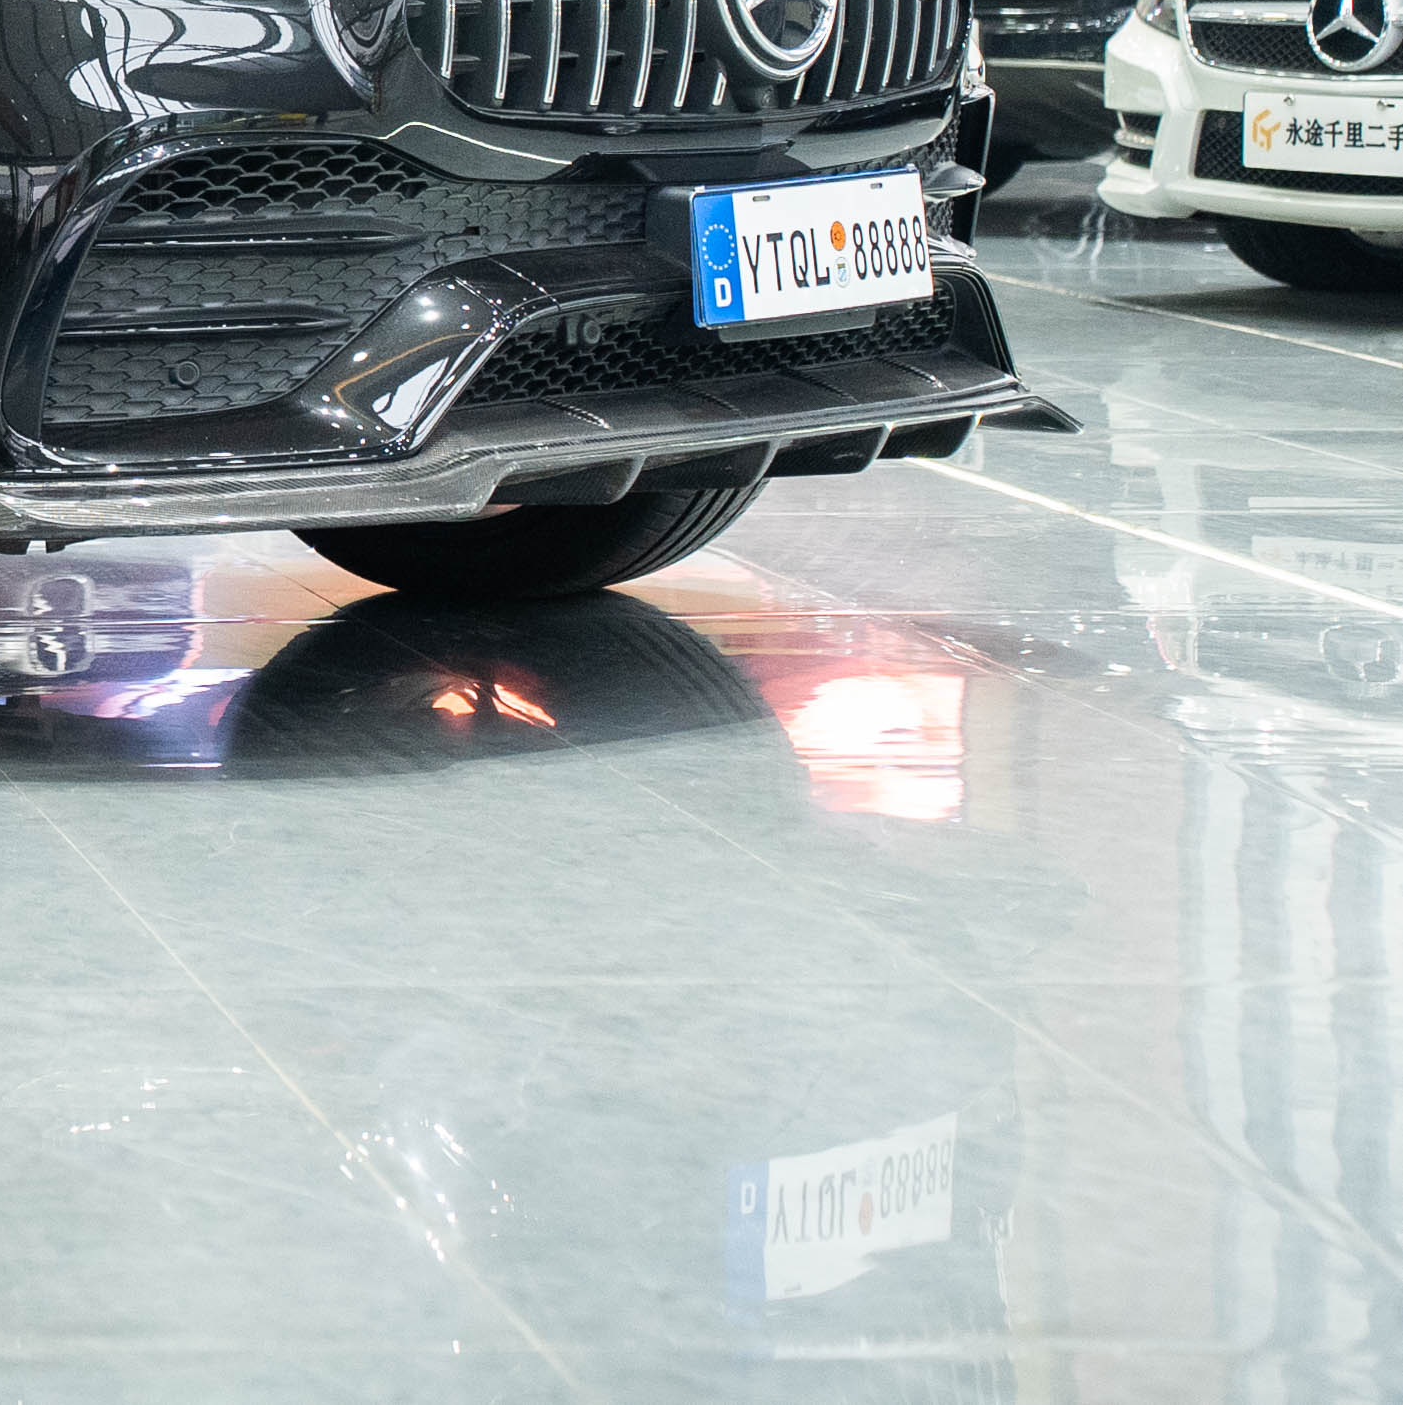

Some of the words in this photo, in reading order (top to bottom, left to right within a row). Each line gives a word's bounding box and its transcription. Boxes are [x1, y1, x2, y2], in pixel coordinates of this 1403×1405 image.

[1286, 117, 1403, 152] 永途千里二手
[741, 227, 831, 295] YTQL
[851, 214, 927, 281] 88888
[713, 277, 733, 309] D
